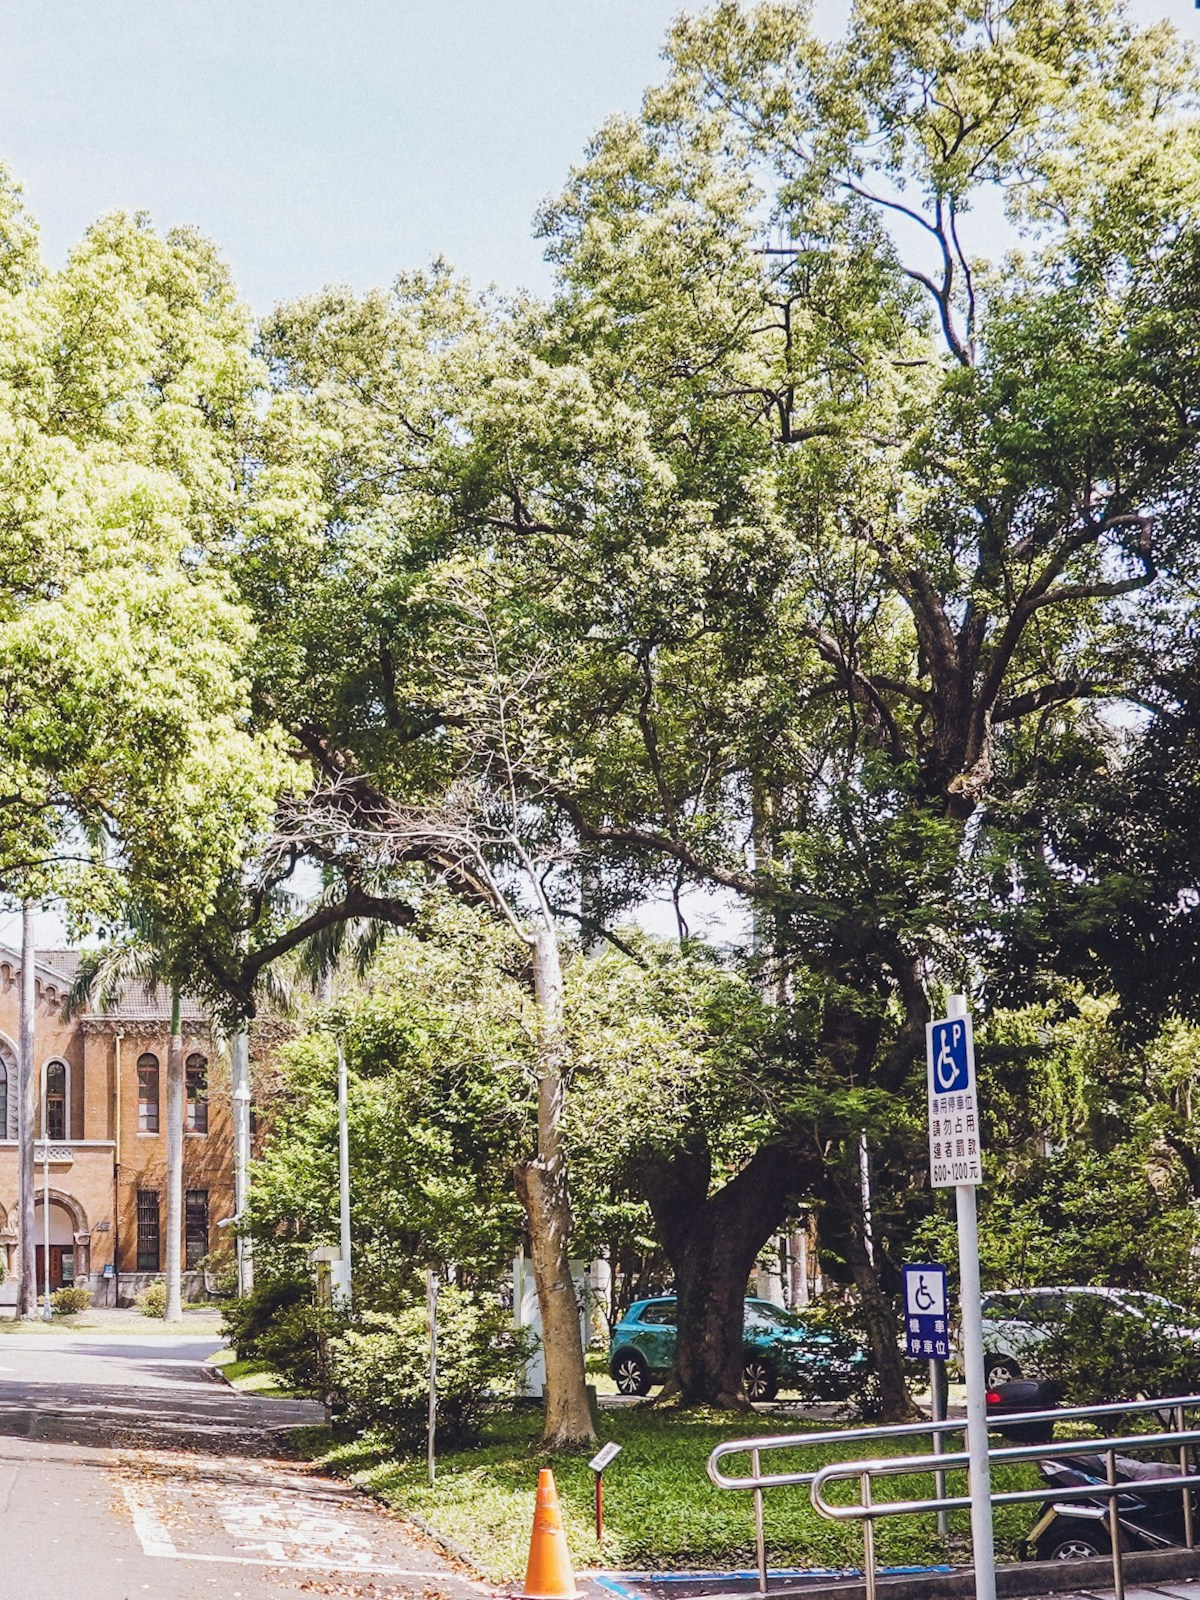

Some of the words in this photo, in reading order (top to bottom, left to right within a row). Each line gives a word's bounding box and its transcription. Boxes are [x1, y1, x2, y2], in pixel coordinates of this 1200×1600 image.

[953, 1024, 961, 1047] P
[932, 1094, 973, 1115] 專用停車位
[933, 1114, 975, 1137] 請勿占用
[934, 1138, 977, 1160] 違者罰款
[911, 1339, 946, 1355] 停車位
